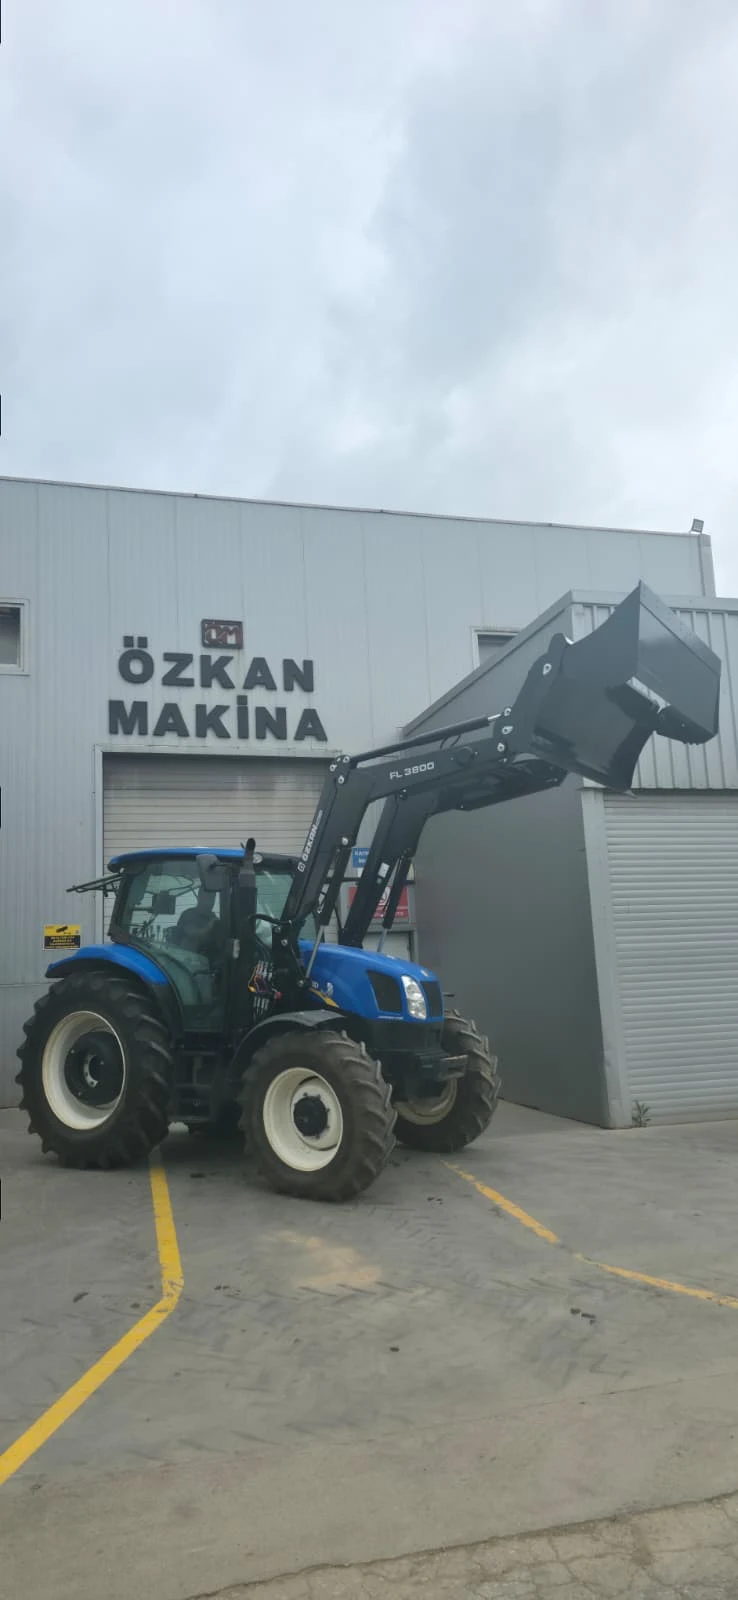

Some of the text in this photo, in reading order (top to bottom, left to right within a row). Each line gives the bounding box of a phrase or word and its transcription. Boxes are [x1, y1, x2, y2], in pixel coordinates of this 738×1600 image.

[118, 635, 315, 692] ÖZKAN
[108, 695, 328, 741] MAKİNA
[389, 761, 435, 780] FL 3800
